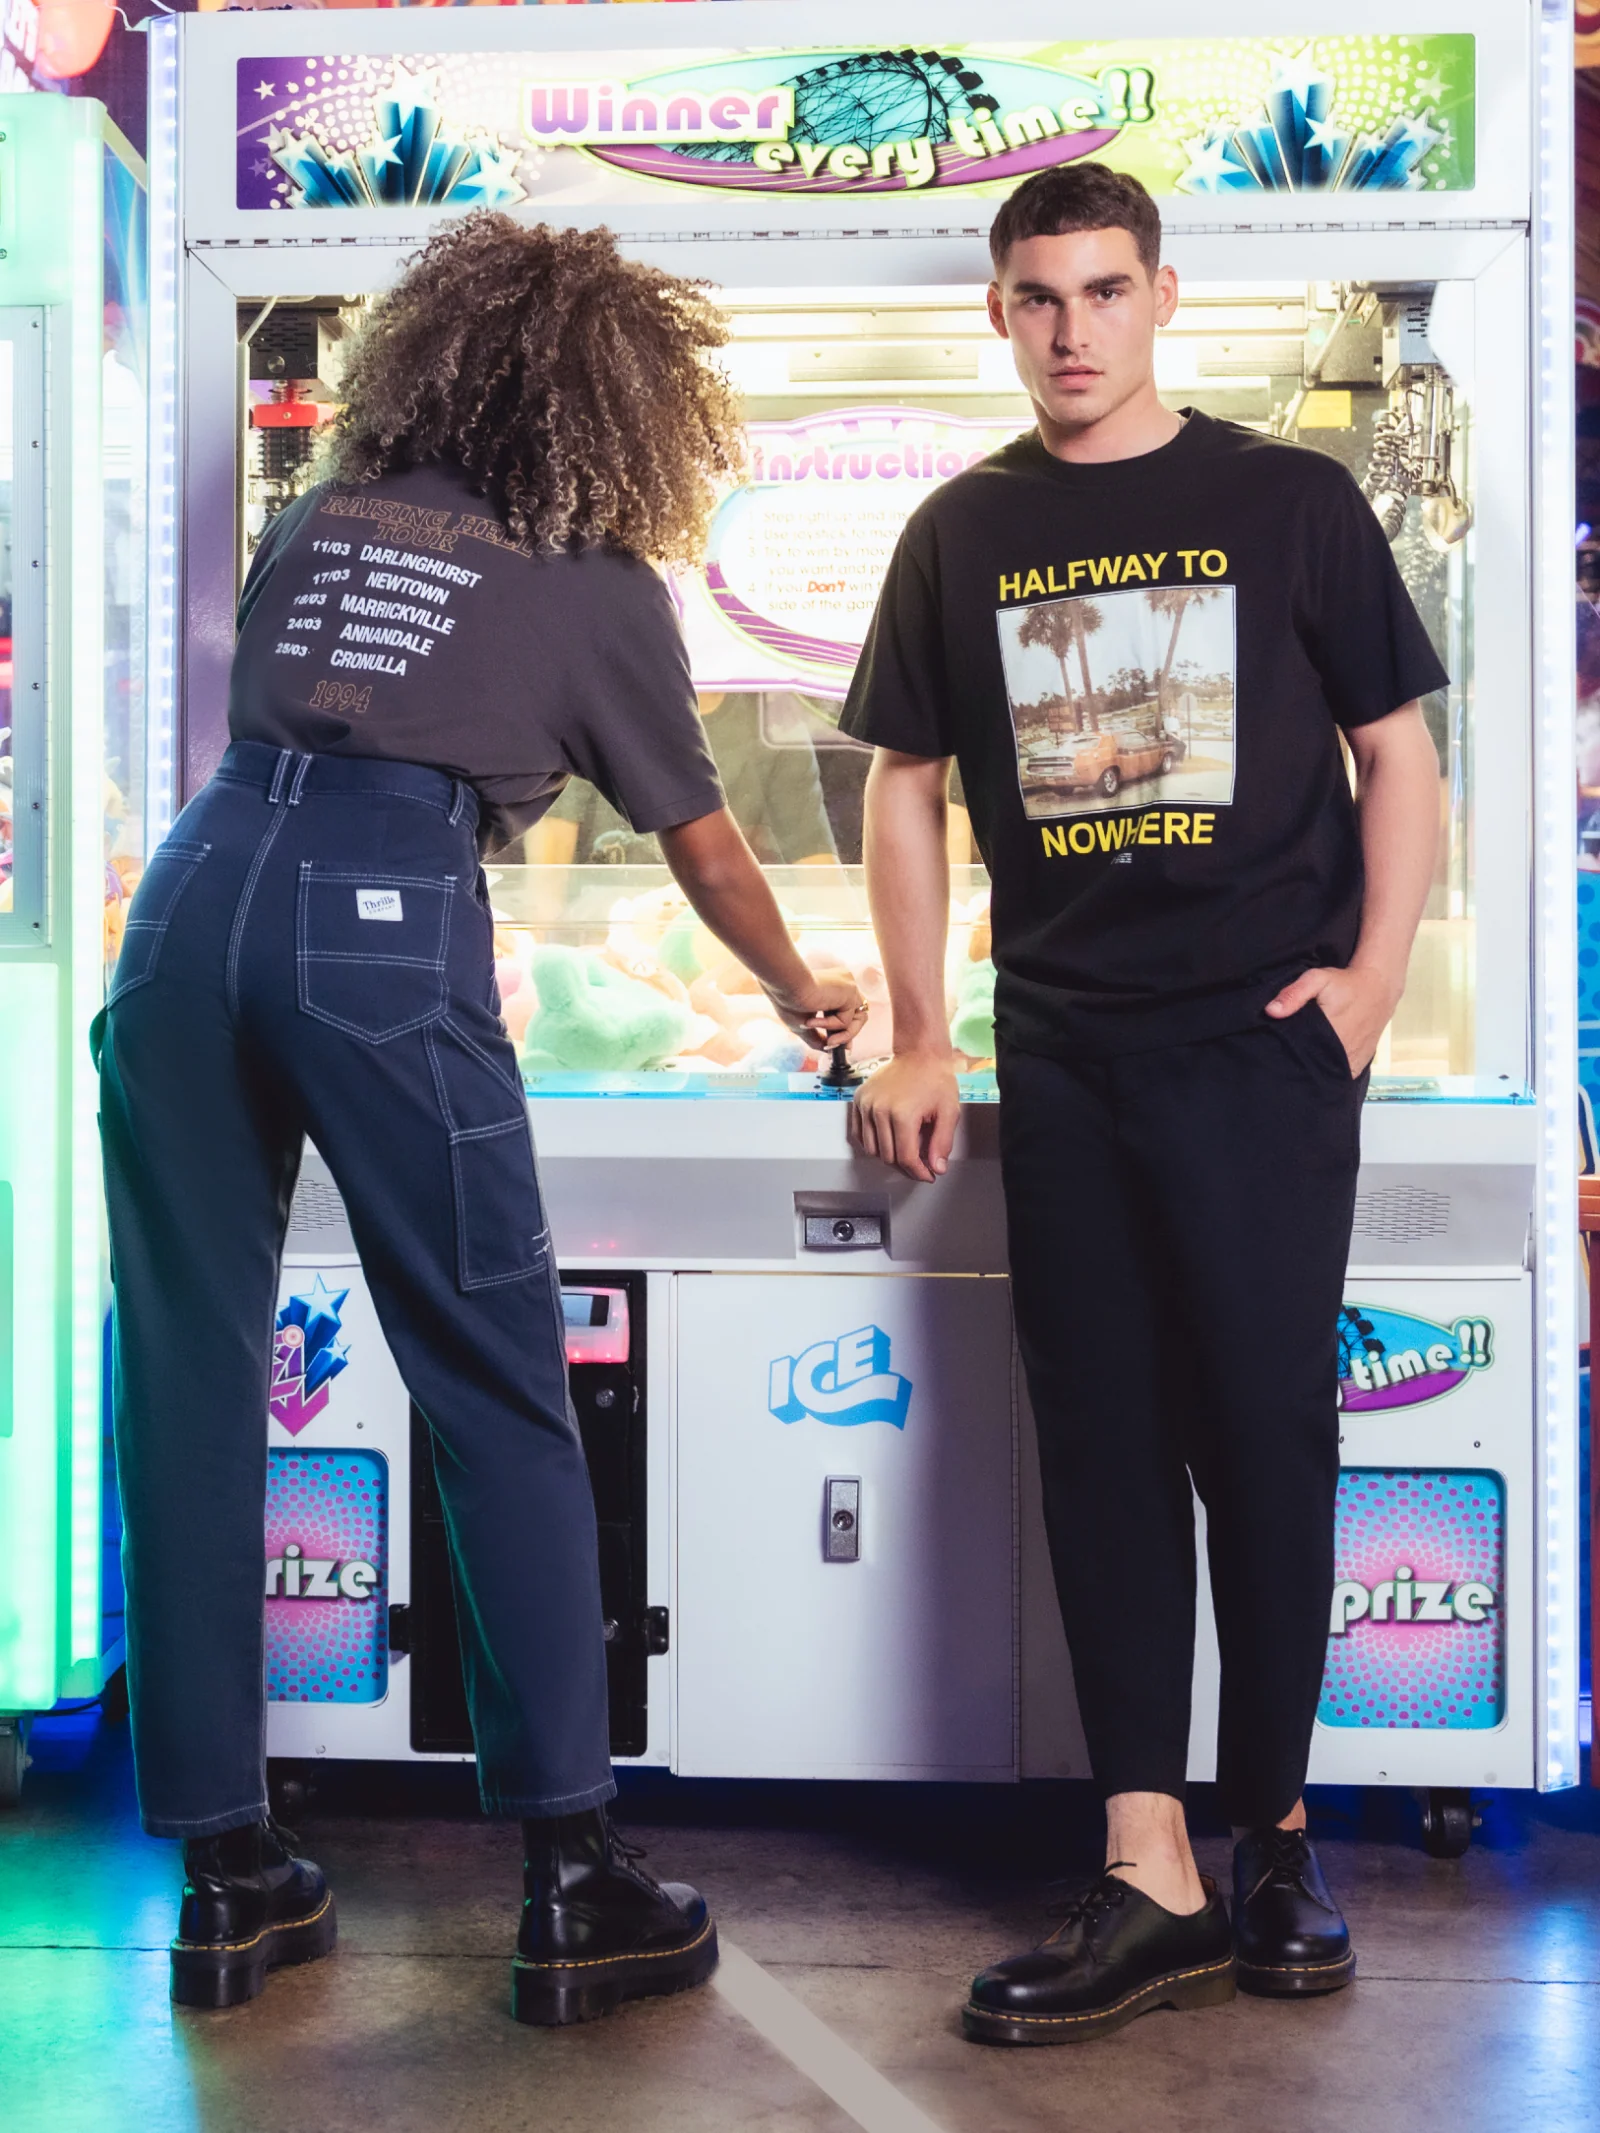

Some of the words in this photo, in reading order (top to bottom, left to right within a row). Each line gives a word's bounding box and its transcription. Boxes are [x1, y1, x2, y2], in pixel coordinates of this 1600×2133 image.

[531, 84, 779, 134] Winner
[753, 137, 936, 188] every
[320, 495, 453, 532] RAISING
[857, 510, 885, 521] and
[373, 519, 459, 553] TOUR
[764, 528, 789, 540] Use
[791, 528, 845, 543] joystick
[851, 528, 866, 539] to
[764, 546, 782, 559] Try
[787, 547, 801, 557] to
[806, 547, 830, 557] win
[833, 546, 850, 559] by
[312, 540, 351, 556] 11/03
[359, 544, 483, 589] DARLINGHURST
[769, 566, 795, 578] you
[800, 563, 833, 576] want
[838, 563, 866, 575] and
[999, 552, 1168, 602] HALFWAY
[1176, 549, 1228, 578] TO
[312, 568, 351, 585] 17/03
[365, 571, 450, 605] NEWTOWN
[768, 599, 797, 611] side
[801, 599, 815, 610] of
[819, 599, 841, 610] the
[777, 583, 803, 596] you
[807, 580, 846, 594] Don't
[849, 582, 872, 592] win
[292, 593, 328, 606] 18/03
[340, 593, 456, 635] MARRICKVILLE
[286, 616, 322, 630] 24/03
[339, 623, 434, 656] ANNANDALE
[274, 642, 308, 657] 25/03
[330, 649, 408, 676] CRONULLA
[309, 680, 372, 714] 1994
[1041, 812, 1216, 858] NOWHERE
[362, 896, 396, 910] Thrills
[768, 1324, 913, 1431] ICE
[1329, 1565, 1495, 1635] prize
